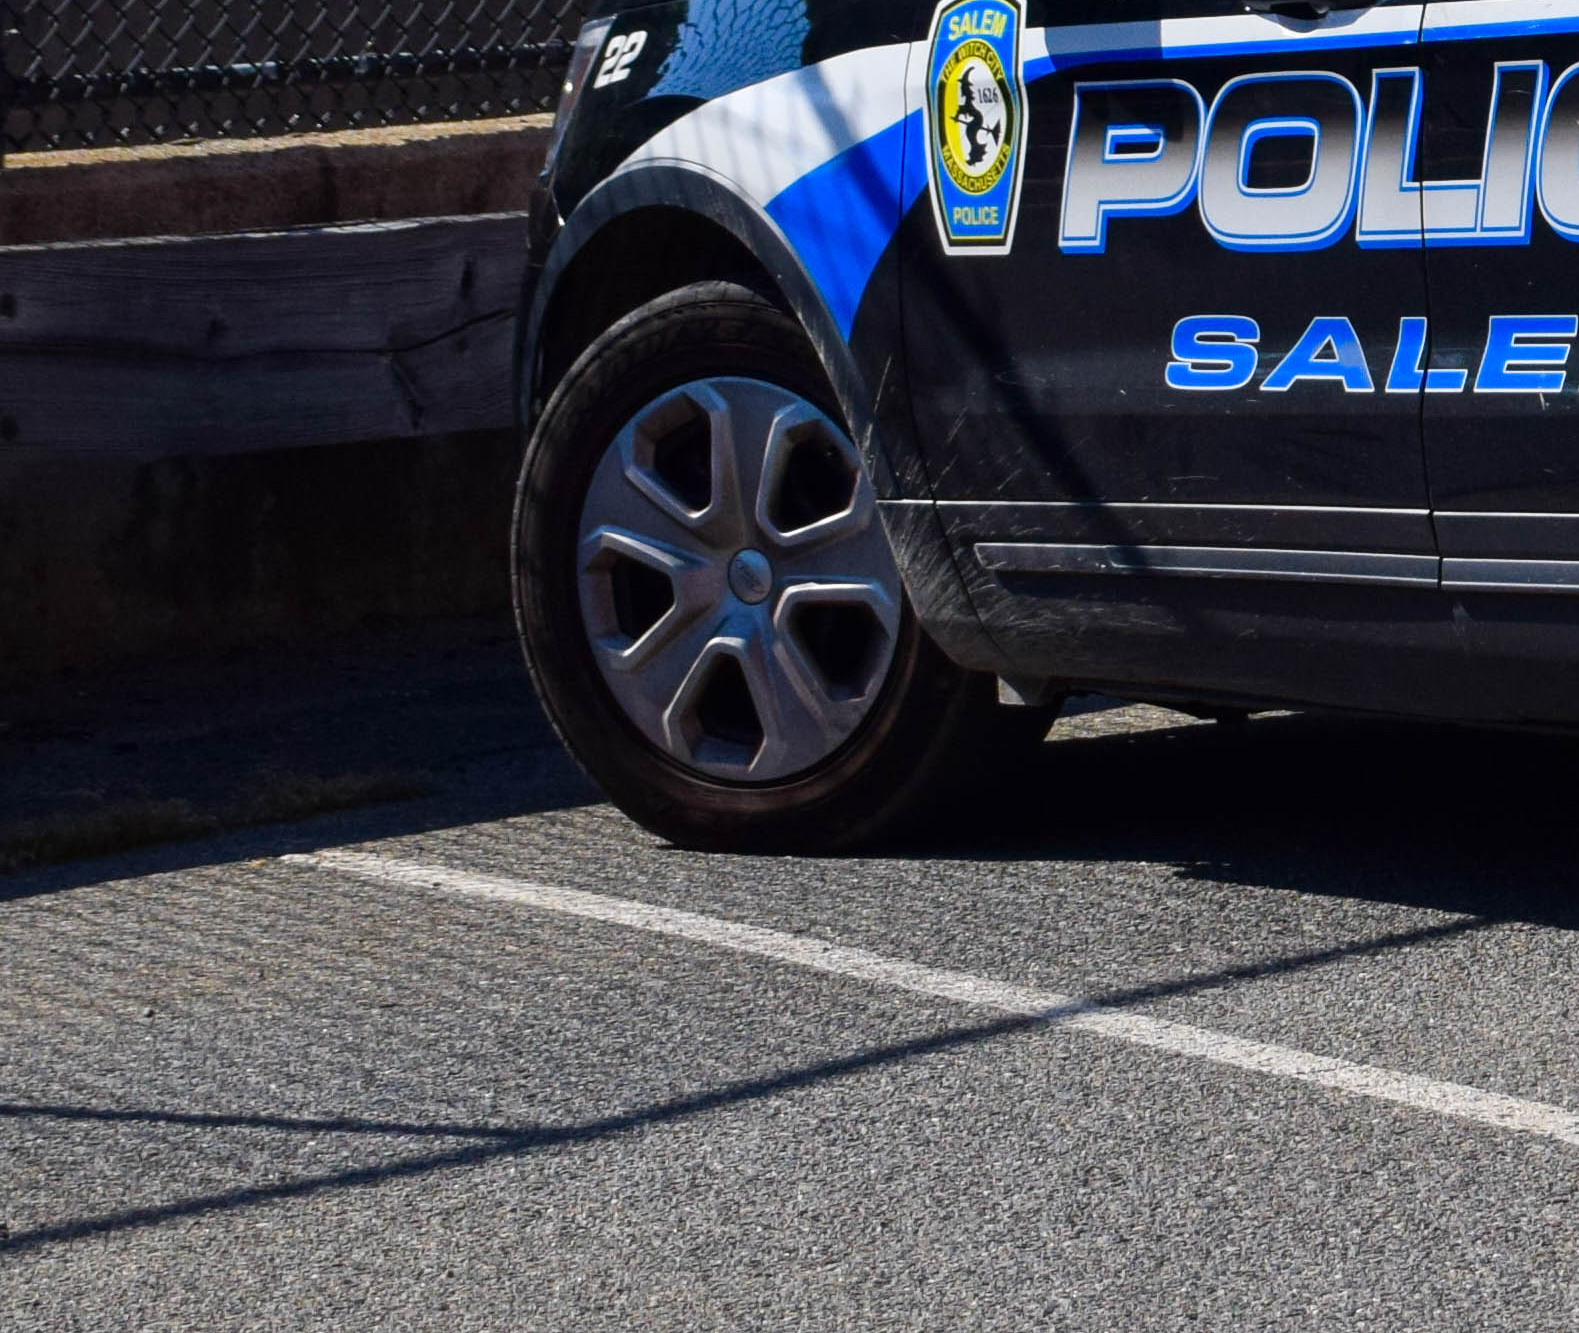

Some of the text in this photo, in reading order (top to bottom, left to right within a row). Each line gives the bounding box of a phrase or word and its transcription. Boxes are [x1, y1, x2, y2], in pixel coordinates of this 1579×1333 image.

[948, 8, 1008, 41] SALEM
[593, 29, 648, 89] 22
[977, 86, 999, 105] 1626
[952, 205, 1000, 226] POLICE
